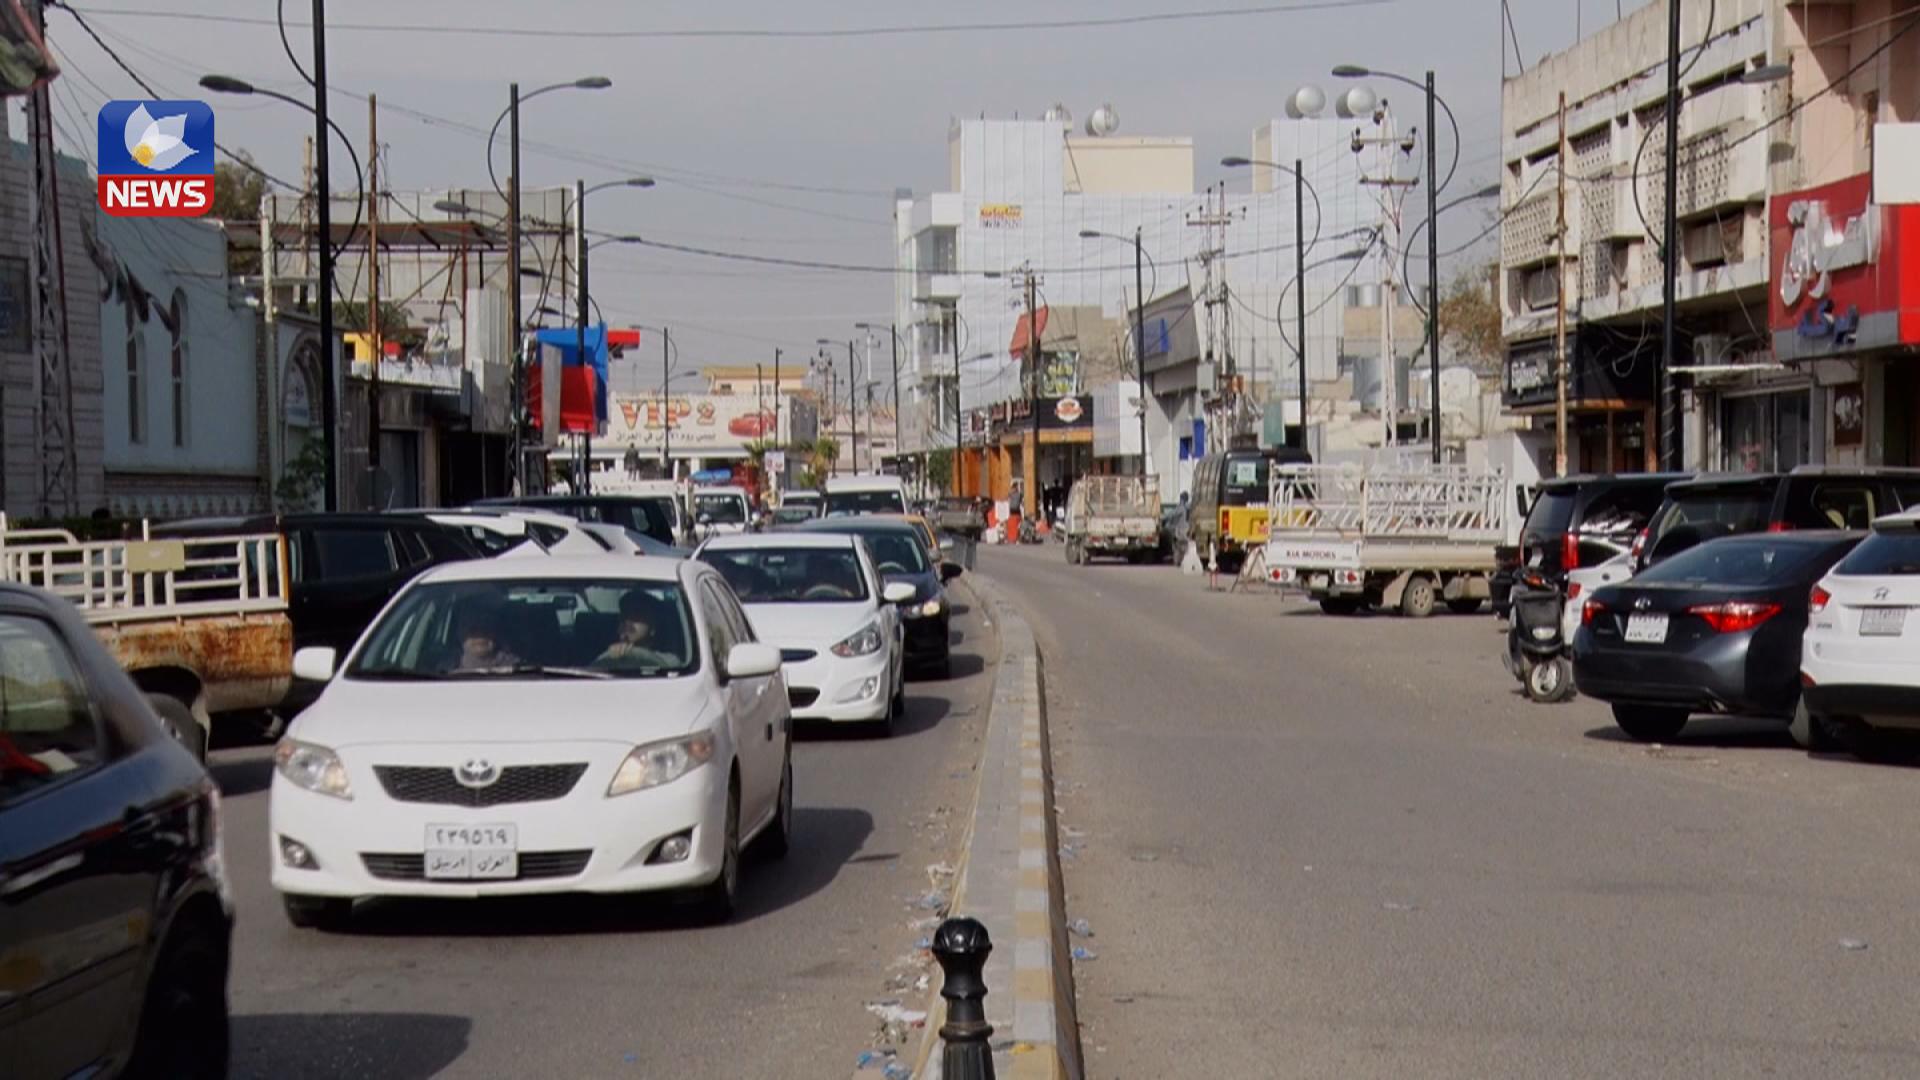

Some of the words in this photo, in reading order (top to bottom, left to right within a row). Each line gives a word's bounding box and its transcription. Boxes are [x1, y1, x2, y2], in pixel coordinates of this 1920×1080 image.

[616, 399, 691, 430] VIP
[696, 400, 716, 426] 2
[1286, 550, 1300, 558] KIA
[1302, 550, 1336, 559] MOTORS
[436, 828, 508, 845] ٢٣٩٥٦٩
